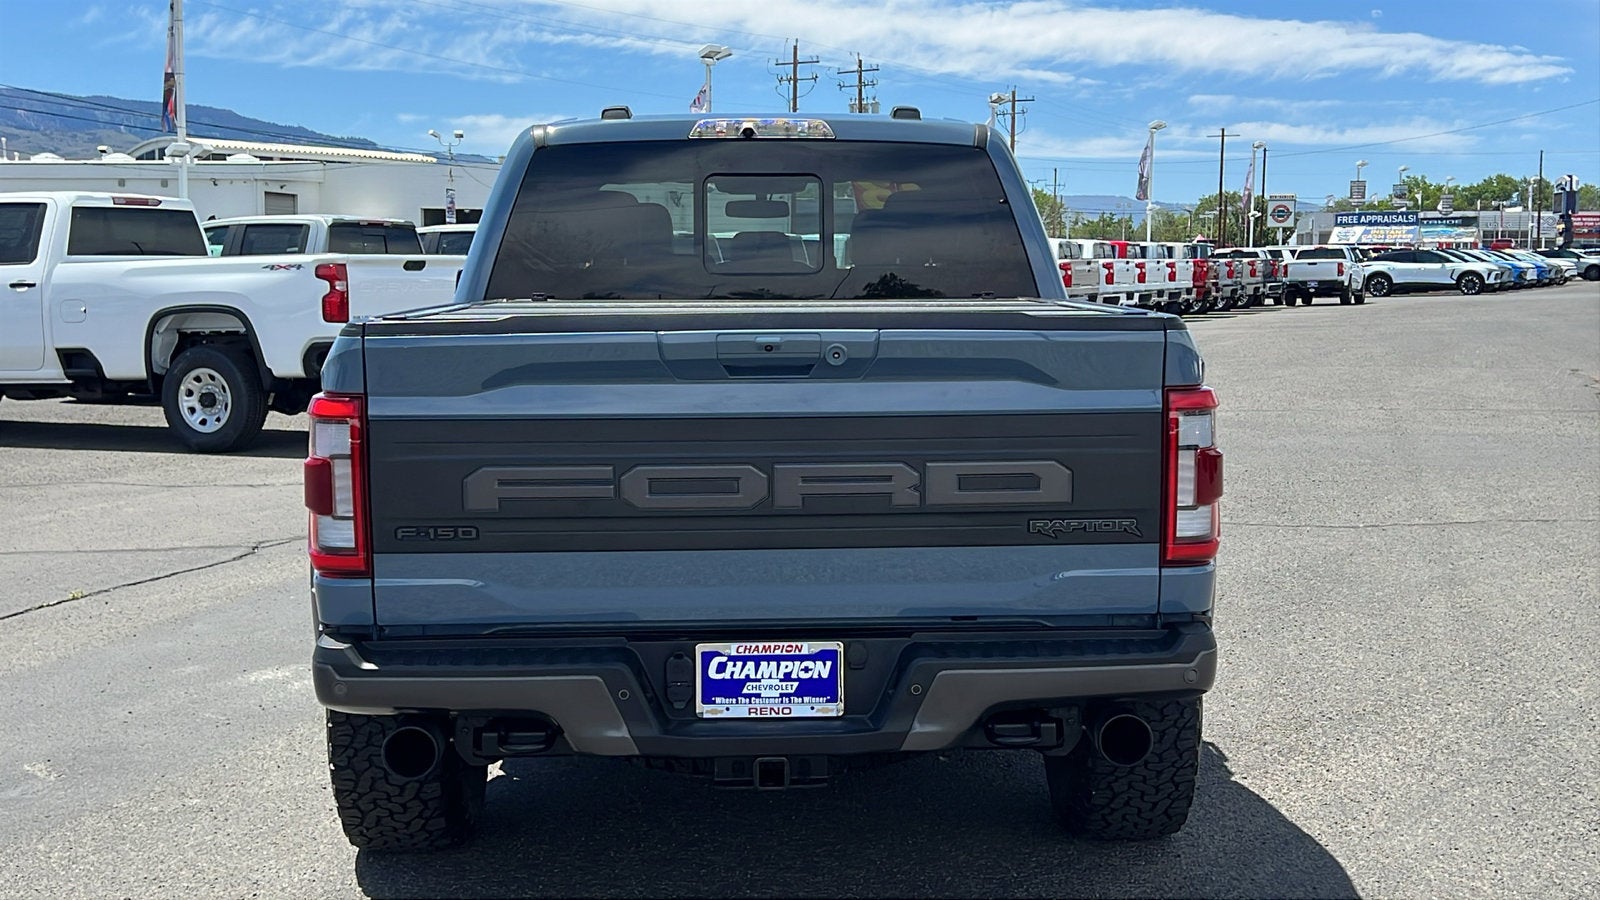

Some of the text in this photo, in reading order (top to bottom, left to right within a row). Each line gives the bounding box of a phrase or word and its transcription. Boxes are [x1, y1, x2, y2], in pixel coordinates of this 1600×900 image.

[1337, 214, 1416, 224] FREE APPRAISALS!
[463, 461, 1073, 512] FORD
[395, 526, 479, 540] F-150
[1028, 519, 1143, 537] RAPTOR
[736, 644, 804, 654] CHAMPION
[708, 656, 832, 680] CHAMPION
[748, 706, 792, 715] RENO
